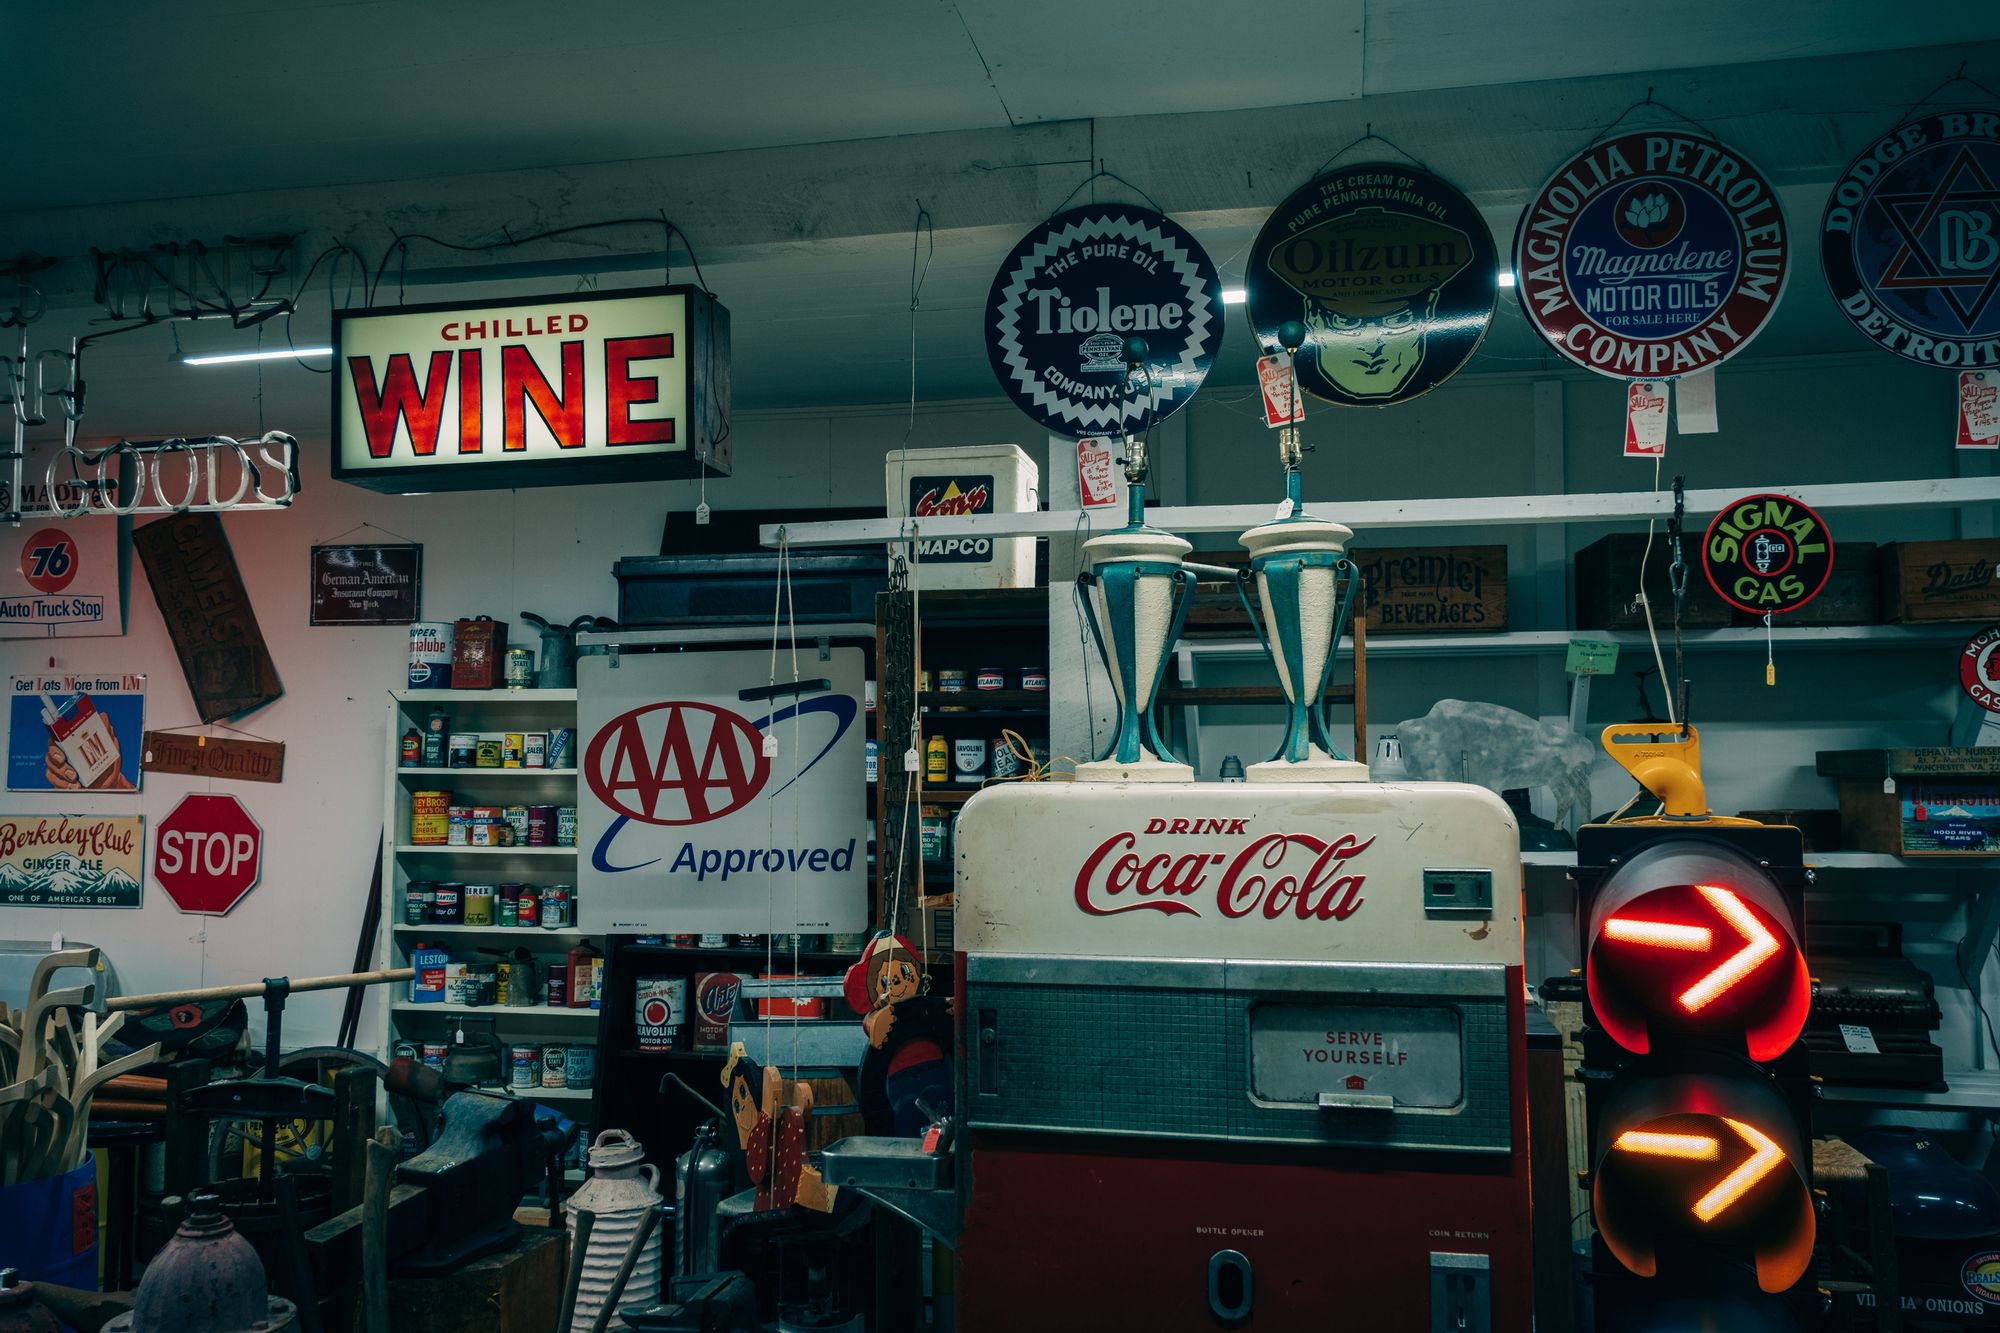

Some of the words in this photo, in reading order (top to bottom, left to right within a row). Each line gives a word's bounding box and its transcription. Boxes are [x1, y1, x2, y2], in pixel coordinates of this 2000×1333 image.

[1319, 178, 1345, 197] THE
[1348, 174, 1394, 187] CREAM
[1398, 177, 1416, 191] OF
[1825, 122, 1928, 235] DODGE
[1287, 203, 1321, 232] PURE
[1323, 187, 1424, 210] PENNSYLVANIA
[1427, 201, 1448, 221] OIL
[1526, 144, 1635, 317] MAGNOLIA
[1645, 136, 1782, 305] PETROLEUM
[1043, 250, 1080, 280] THE
[1081, 243, 1131, 261] PURE
[1135, 249, 1161, 276] OIL
[1284, 238, 1457, 275] Oilzum
[1571, 240, 1735, 285] Magnolene
[1302, 274, 1383, 289] MOTOR
[1391, 272, 1441, 285] OILS
[1586, 285, 1663, 313] MOTOR
[1667, 281, 1720, 309] OILS
[1026, 286, 1184, 335] Tiolene
[1604, 314, 1631, 327] FOR
[1632, 312, 1664, 326] SALE
[1664, 311, 1702, 323] HERE
[440, 313, 589, 341] CHILLED
[1565, 311, 1746, 373] COMPANY
[347, 333, 676, 459] WINE
[1962, 385, 1978, 398] SALE
[45, 429, 301, 519] GOODS
[1709, 500, 1826, 565] SIGNAL
[913, 537, 991, 555] MAPCO
[1769, 543, 1784, 552] GO
[29, 541, 71, 578] 76
[322, 570, 360, 586] German
[361, 569, 410, 586] American
[1920, 558, 1995, 595] Daily
[330, 586, 367, 599] Insurance
[366, 586, 400, 600] Company
[1733, 573, 1805, 605] GAS
[72, 598, 102, 620] Stop
[348, 599, 363, 609] New
[363, 599, 380, 611] York
[1382, 602, 1486, 624] BEVERAGES
[409, 628, 437, 638] SUPER
[513, 660, 529, 668] STATE
[15, 679, 33, 691] Get
[37, 678, 61, 692] Lots
[63, 677, 93, 691] More
[95, 677, 120, 691] from
[551, 730, 569, 758] UNIFLO
[956, 744, 983, 753] HAVOLINE
[1914, 748, 1961, 758] DEHAVEN
[152, 739, 206, 769] Finest
[208, 746, 272, 777] Quality
[592, 702, 763, 822] AAA
[1144, 816, 1251, 836] DRINK
[0, 818, 91, 858] Berkeley
[90, 822, 135, 856] Club
[22, 858, 71, 871] GINGER
[78, 858, 104, 871] ALE
[159, 830, 256, 877] STOP
[669, 838, 858, 882] Approved
[1073, 831, 1378, 922] Coca-Cola
[7, 894, 26, 903] ONE
[29, 894, 42, 903] OF
[47, 895, 92, 904] AMERICA'S
[97, 896, 118, 904] BEST
[465, 887, 490, 896] ZEREX
[637, 1025, 678, 1037] HAVOLINE
[639, 1037, 662, 1045] MOTOR
[661, 1037, 673, 1045] OIL
[699, 1026, 724, 1034] MOTOR
[1326, 1031, 1384, 1047] SERVE
[1302, 1048, 1409, 1067] YOURSELF
[1195, 1225, 1228, 1236] BOTTLE
[1230, 1227, 1265, 1238] OPENER
[1428, 1229, 1451, 1238] COIN
[1454, 1230, 1490, 1240] RETURN
[1925, 1297, 1985, 1316] ONIONS
